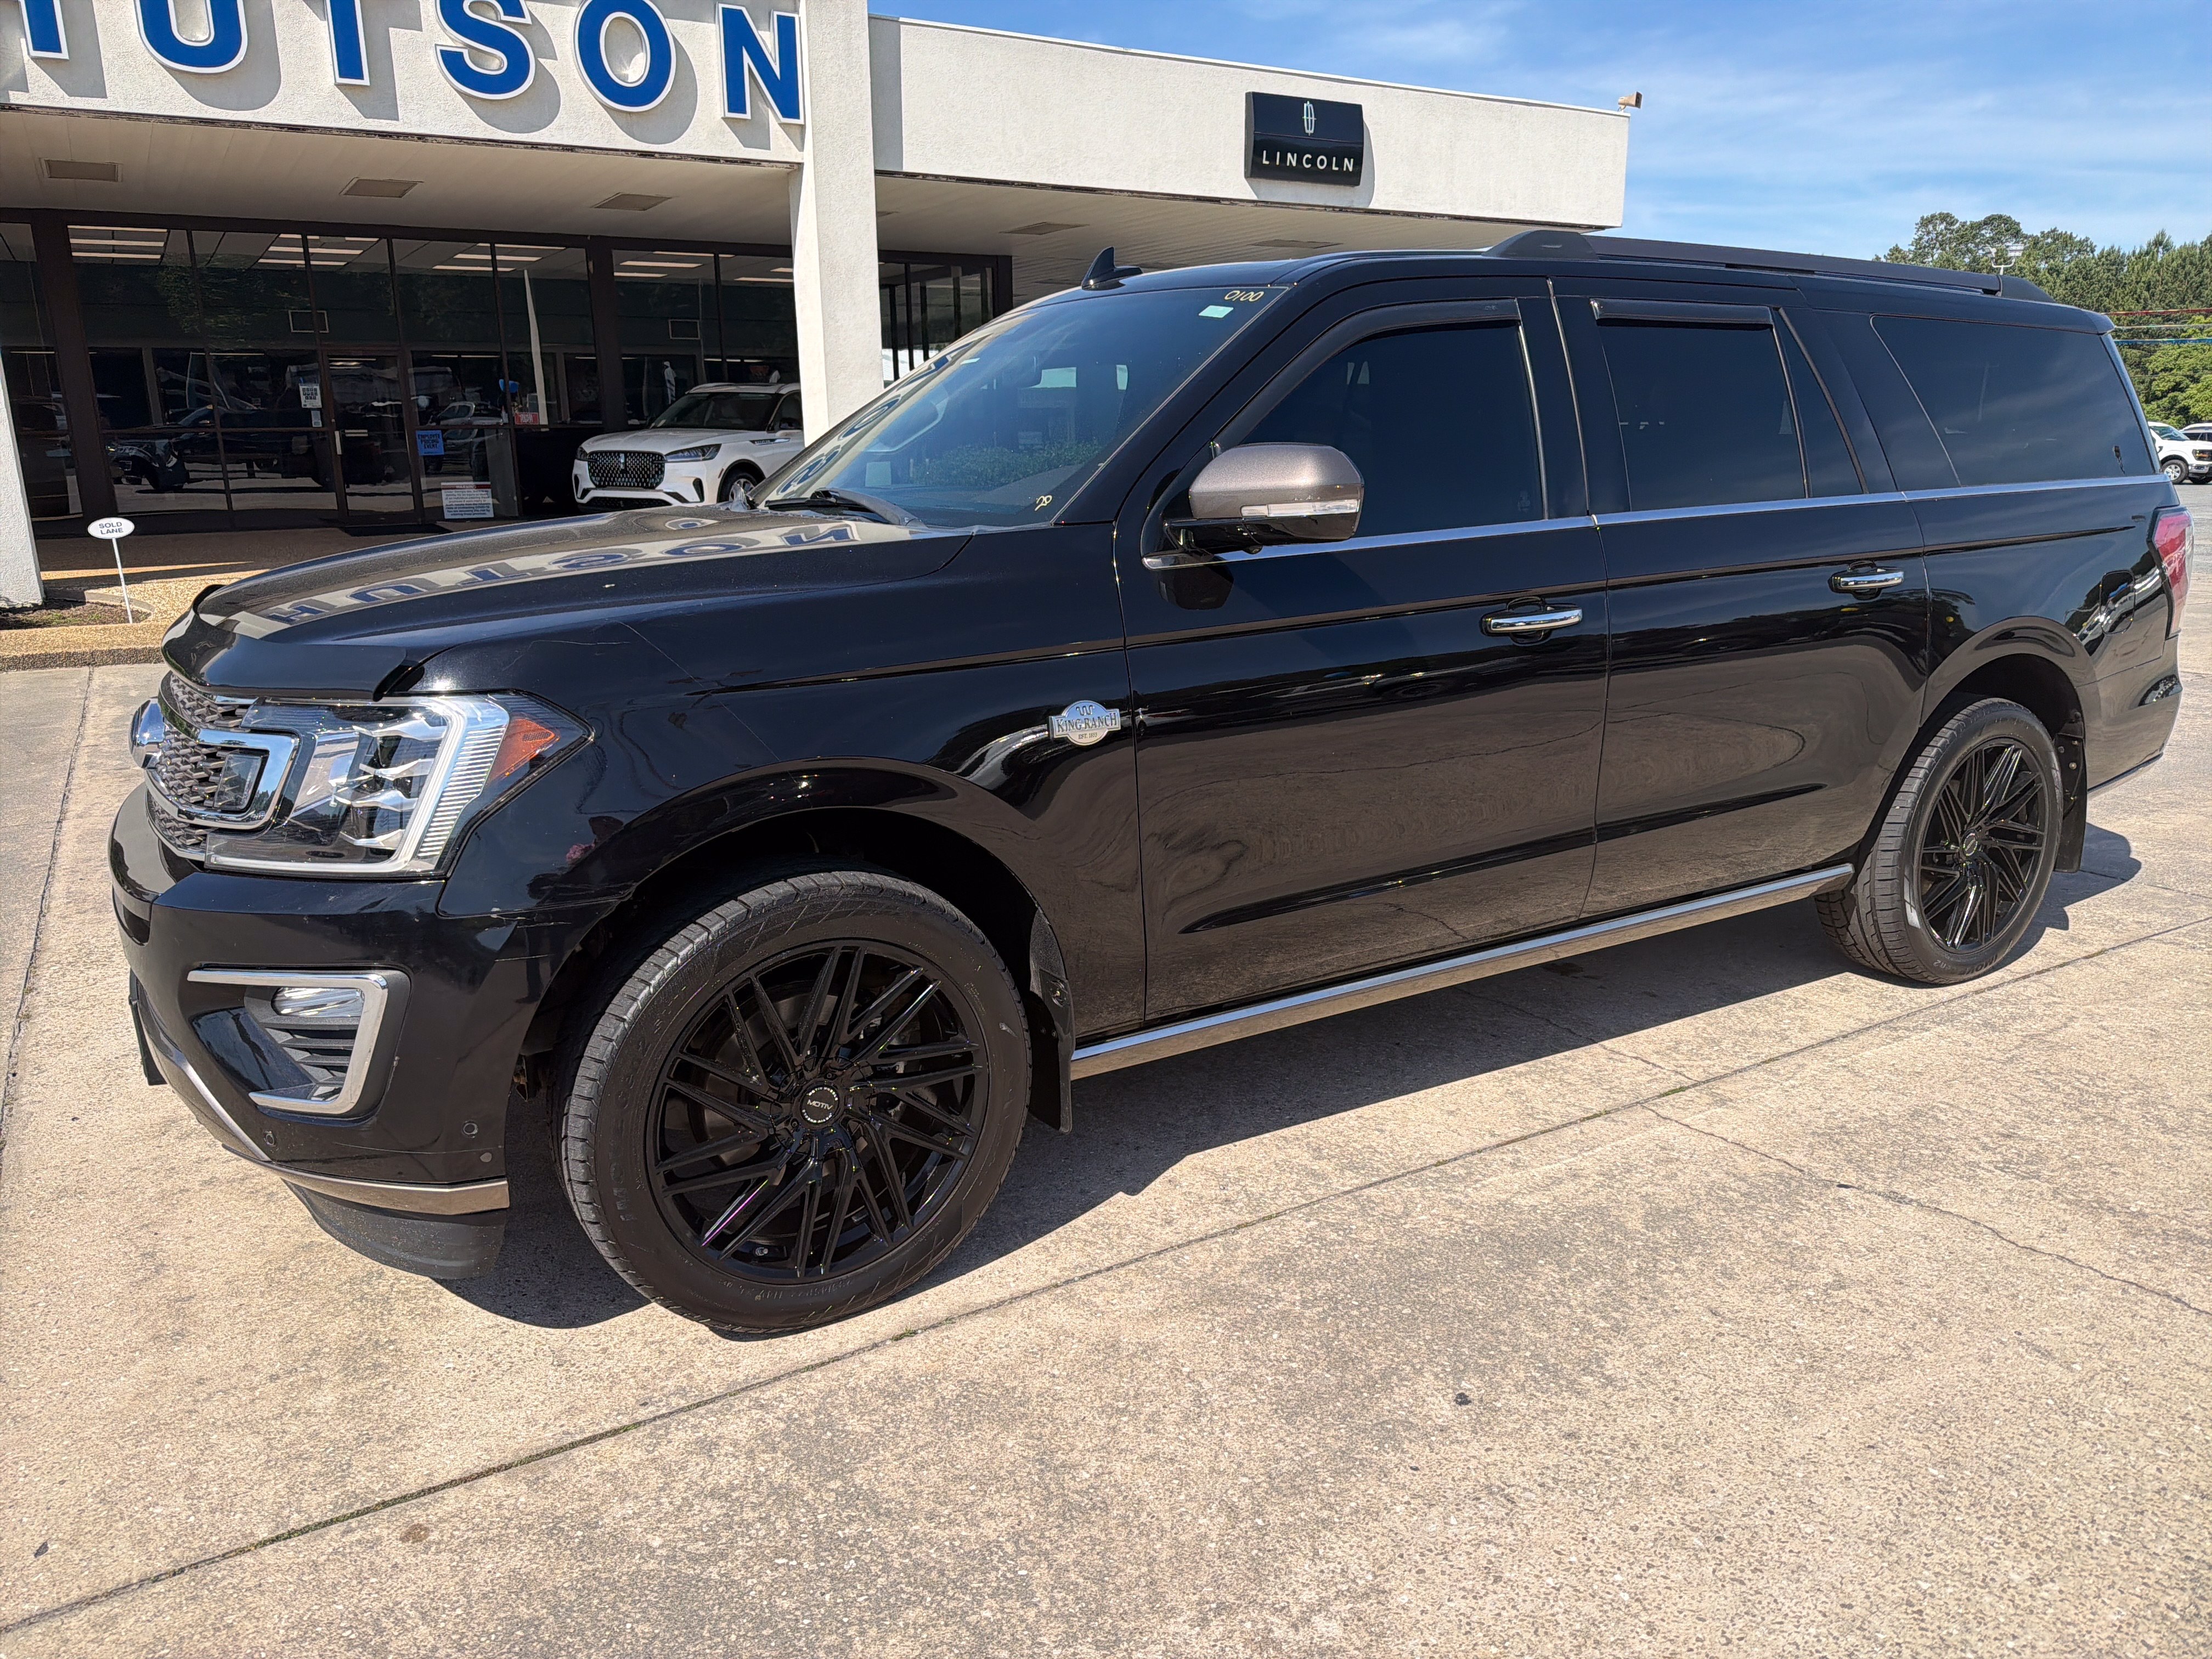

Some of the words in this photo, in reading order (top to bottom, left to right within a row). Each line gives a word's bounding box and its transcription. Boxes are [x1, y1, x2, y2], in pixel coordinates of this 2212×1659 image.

[1262, 149, 1354, 172] LINCOLN
[1057, 718, 1082, 733] KING
[1084, 713, 1118, 730] RANCH
[807, 1099, 833, 1110] MOTIV
